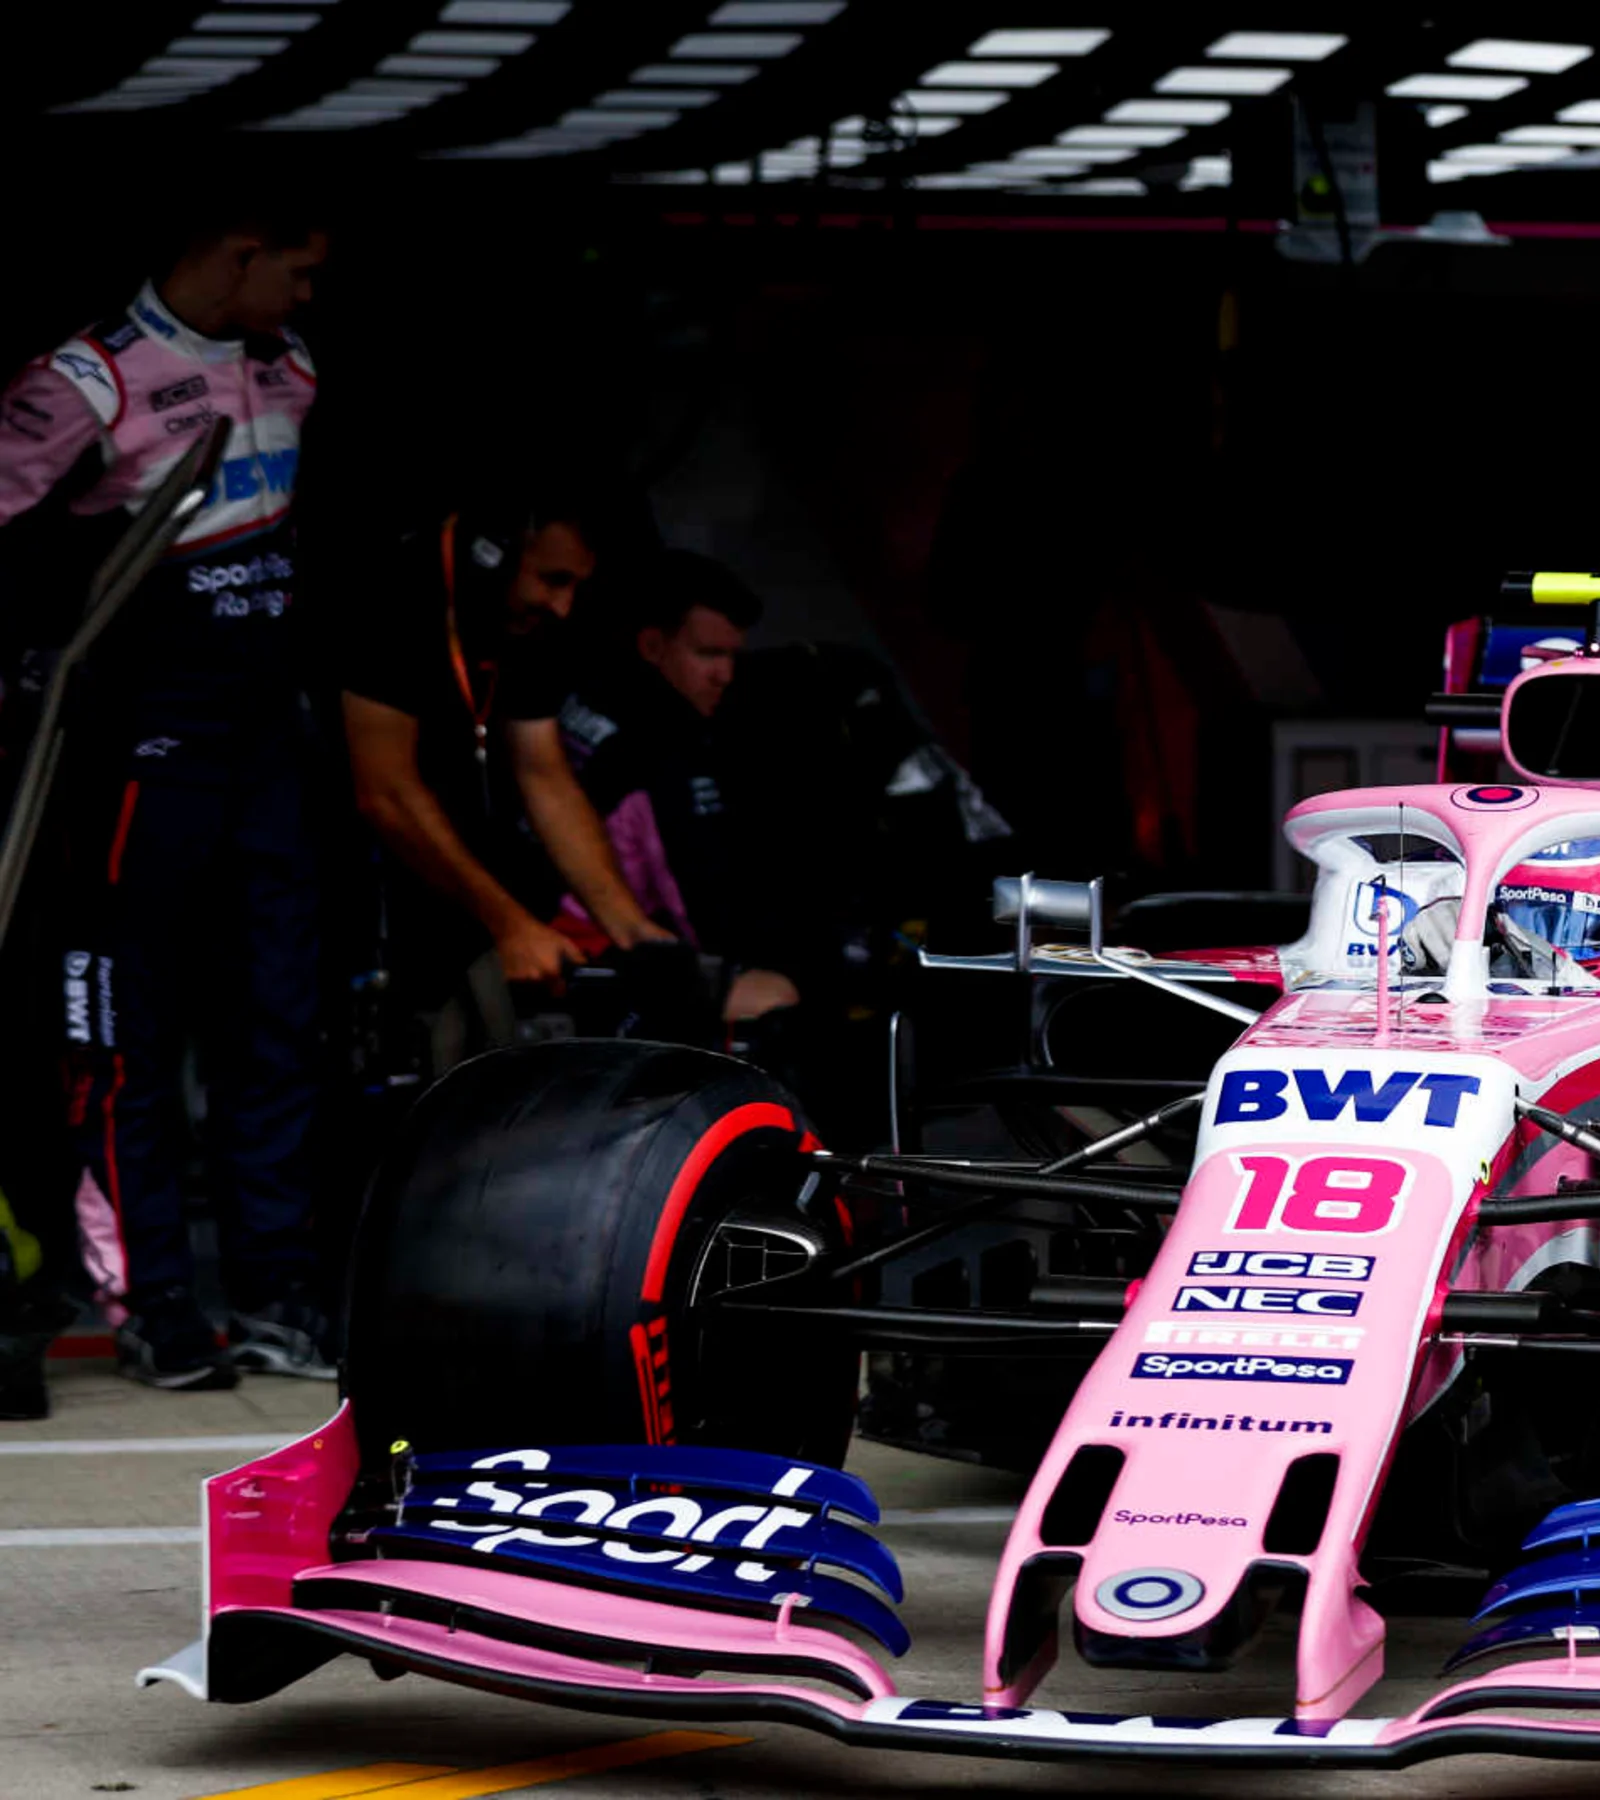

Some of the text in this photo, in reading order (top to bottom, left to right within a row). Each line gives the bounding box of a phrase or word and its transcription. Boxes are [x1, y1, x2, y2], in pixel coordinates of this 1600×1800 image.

[224, 450, 298, 499] BW
[1500, 885, 1567, 904] SportPesa
[1213, 1068, 1482, 1128] BWT
[1226, 1153, 1412, 1236] 18
[1192, 1252, 1370, 1279] JCB
[1175, 1287, 1359, 1315] NEC
[1143, 1320, 1367, 1350] PIRELLI
[1142, 1354, 1343, 1379] SportPesa
[1108, 1410, 1334, 1434] infinitum
[429, 1448, 815, 1582] Sport
[1113, 1509, 1248, 1527] SportPesa
